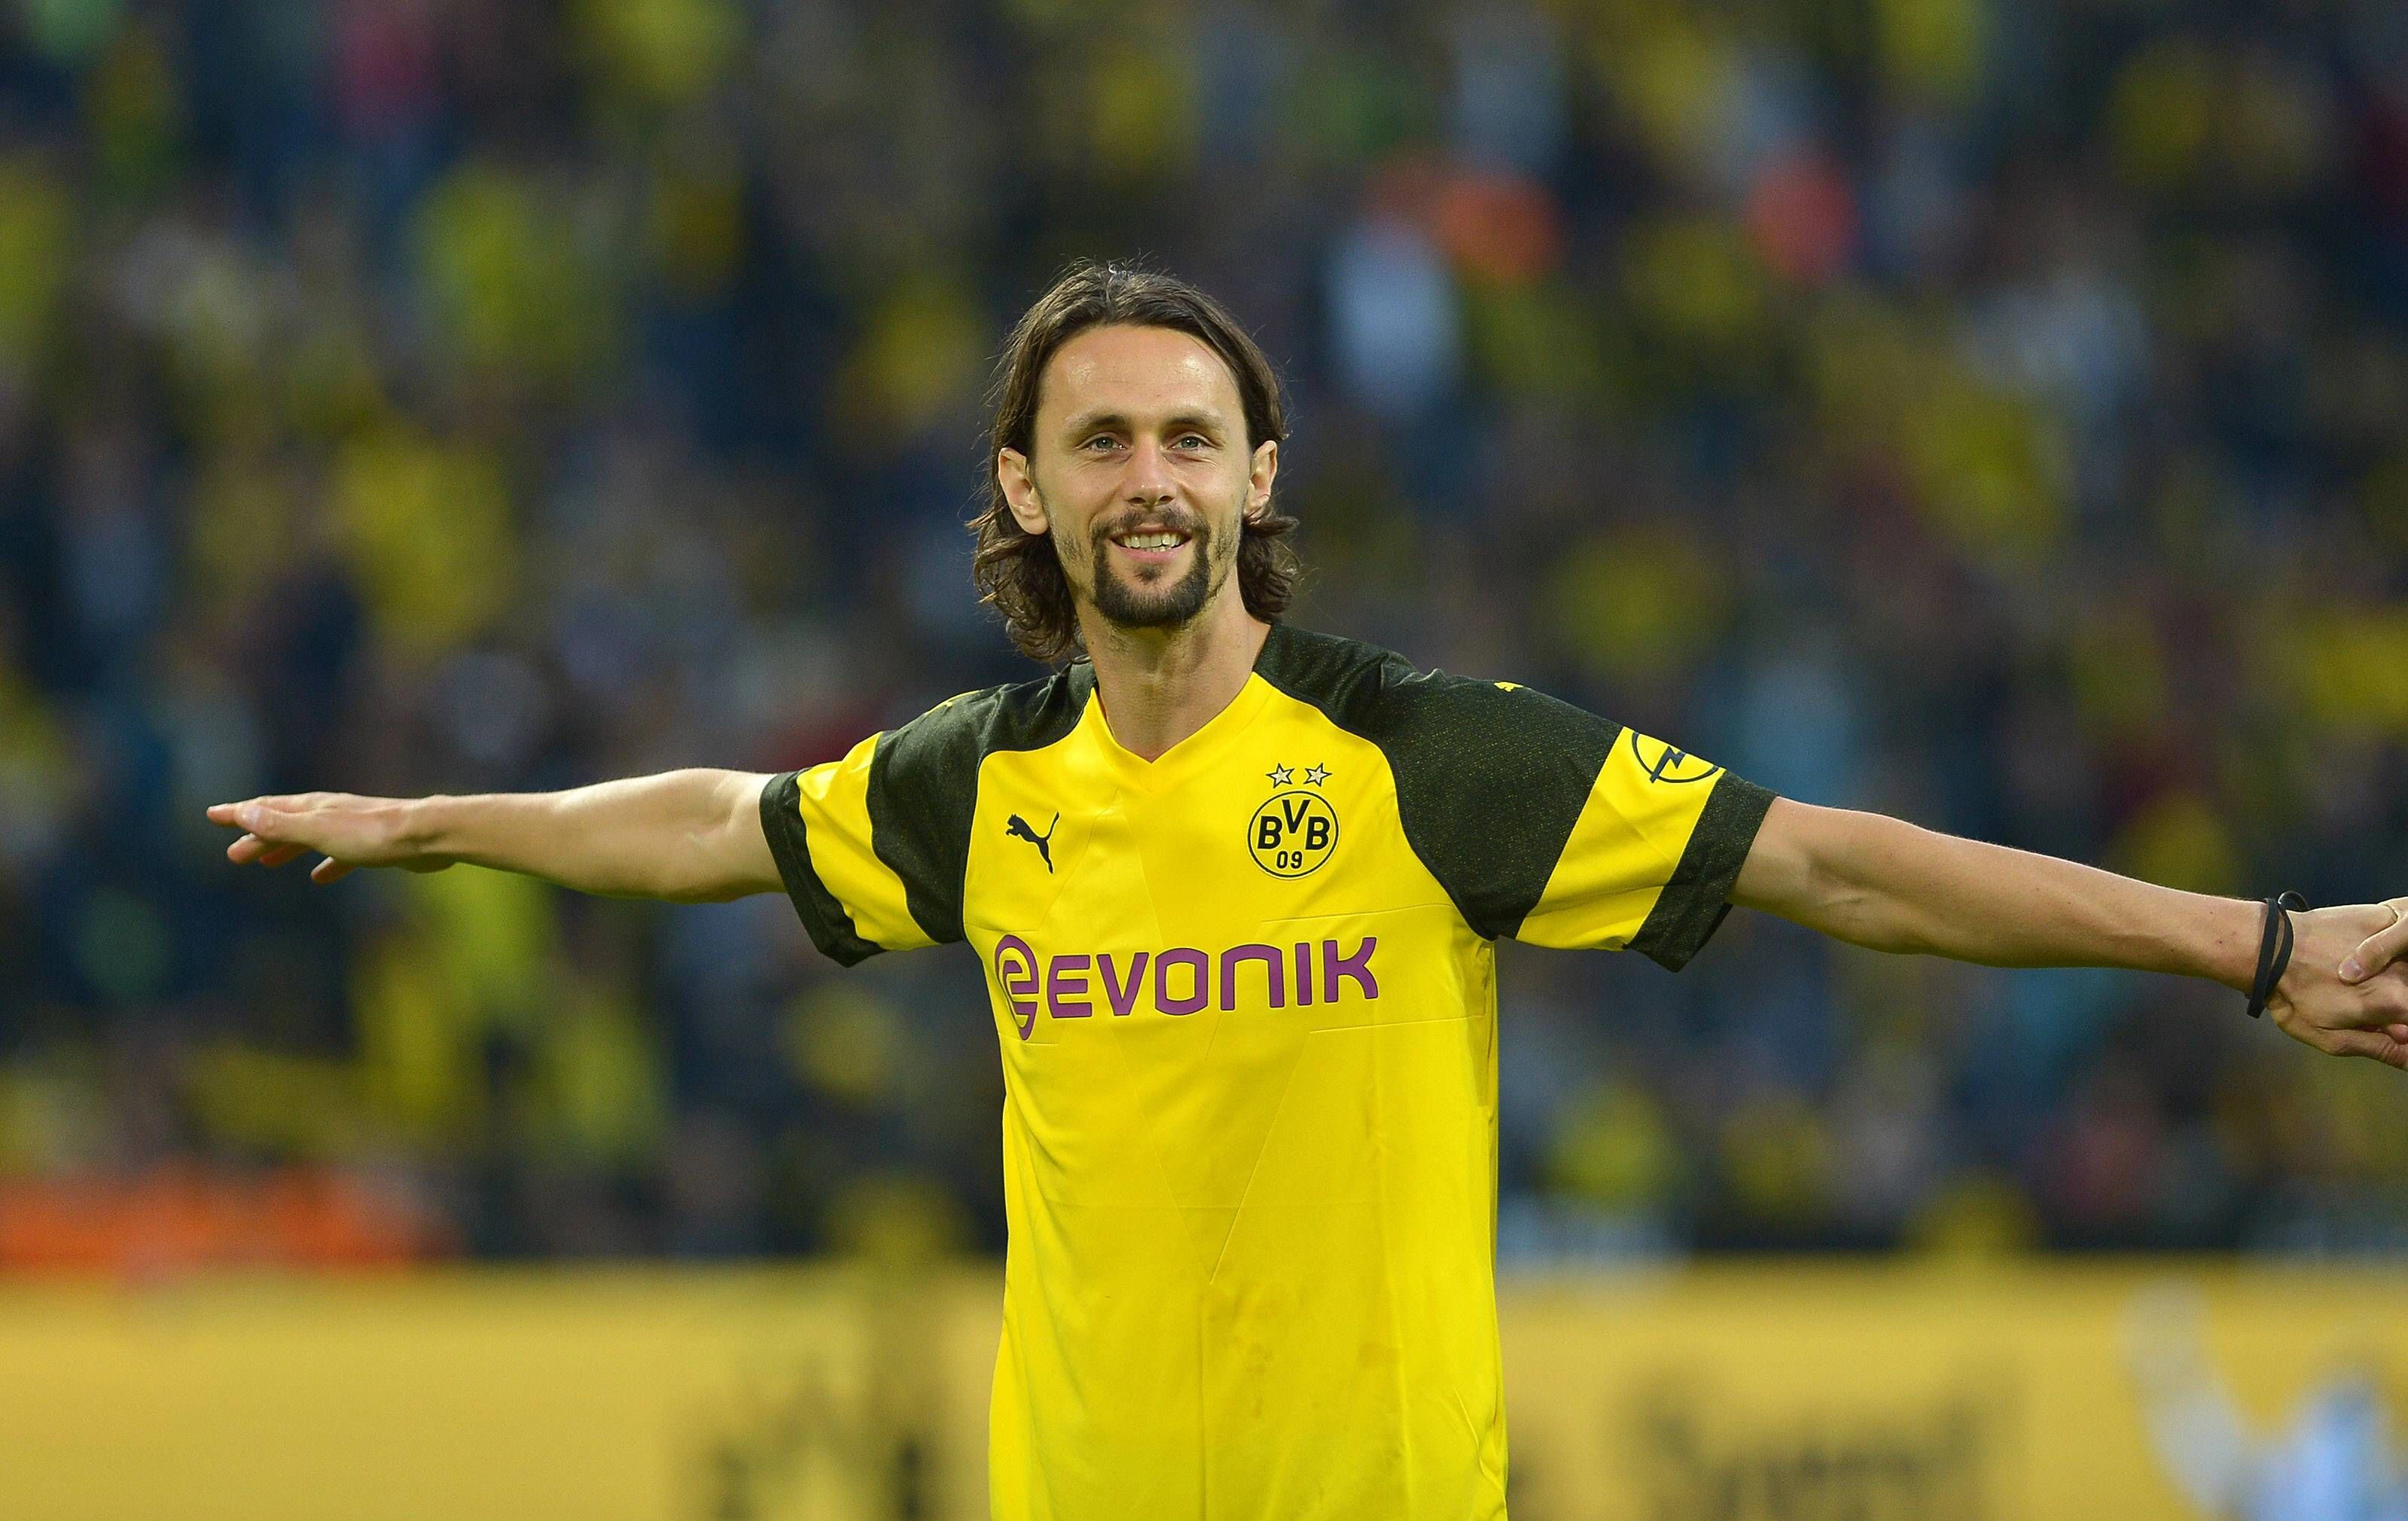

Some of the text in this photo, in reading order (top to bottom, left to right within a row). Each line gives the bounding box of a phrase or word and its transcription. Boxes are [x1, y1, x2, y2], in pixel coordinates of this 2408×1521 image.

[1257, 799, 1330, 850] BVB
[1276, 850, 1303, 869] 09
[1047, 936, 1379, 1020] EVONIK
